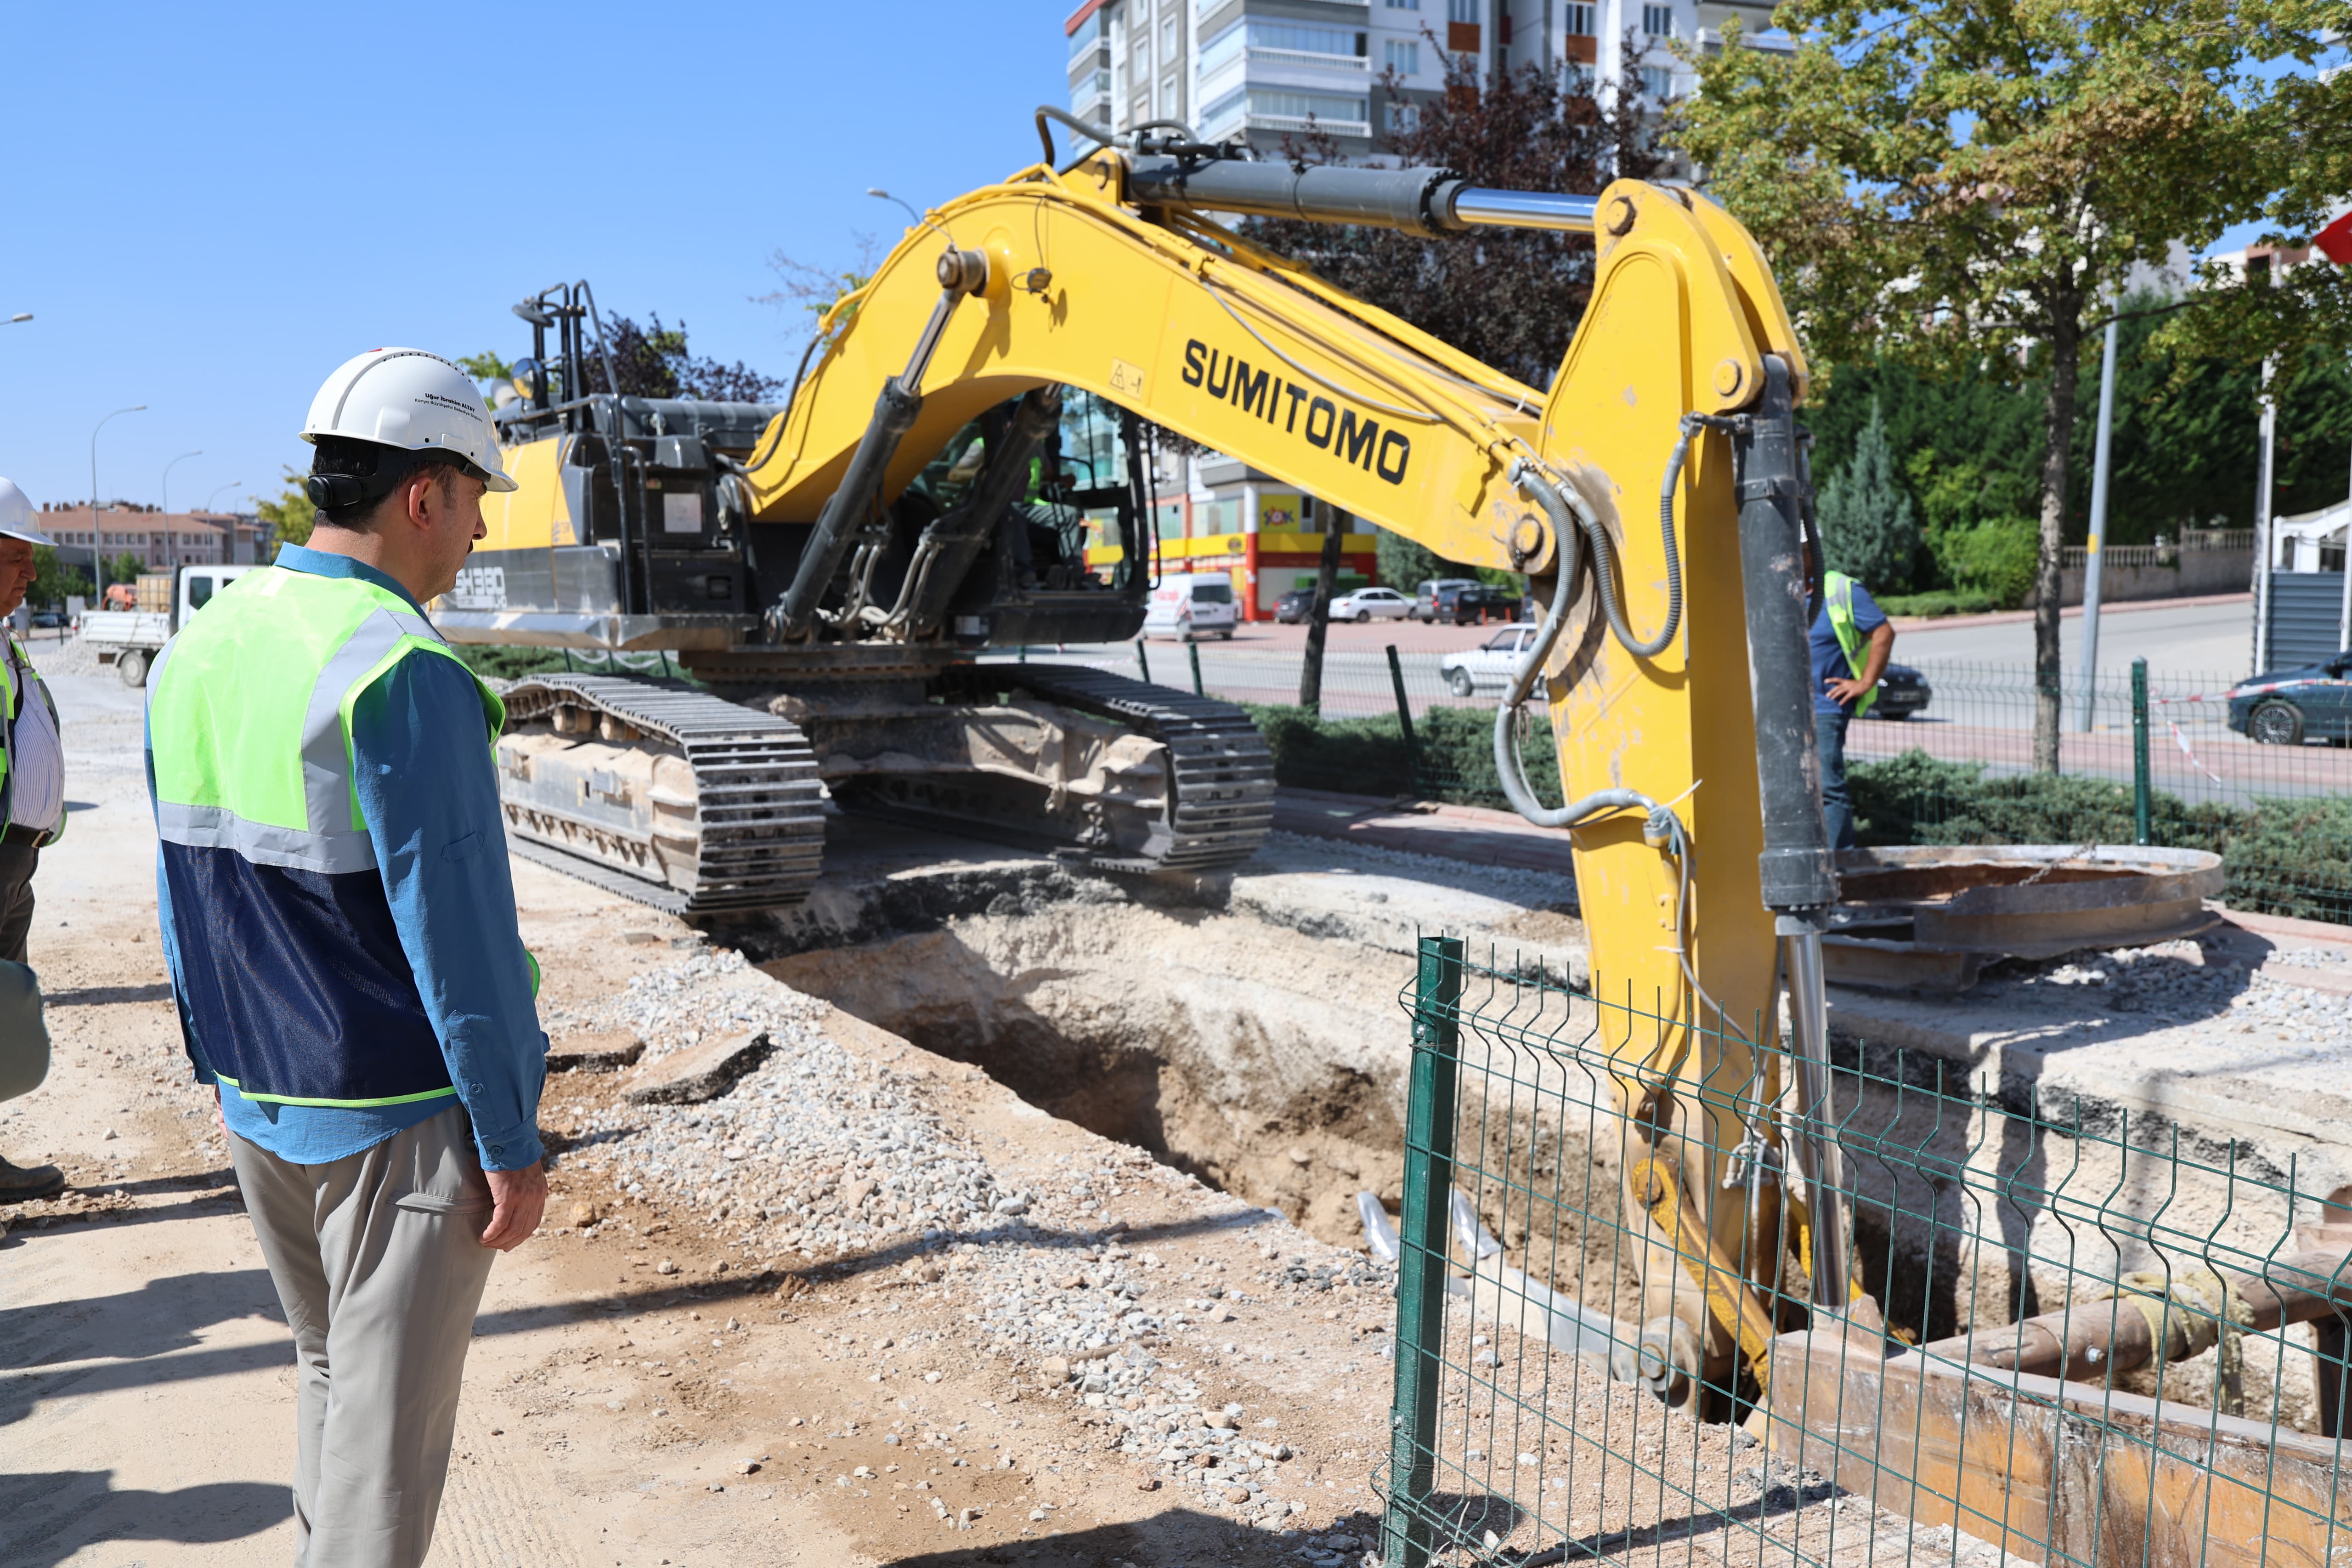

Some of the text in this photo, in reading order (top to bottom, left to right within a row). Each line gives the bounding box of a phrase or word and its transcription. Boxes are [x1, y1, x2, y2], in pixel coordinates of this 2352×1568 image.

[430, 401, 453, 409] Büyükşehir
[454, 407, 470, 416] Belediye
[440, 395, 461, 406] İbrahim
[462, 403, 475, 412] ALTAY
[1182, 339, 1410, 485] SUMITOMO
